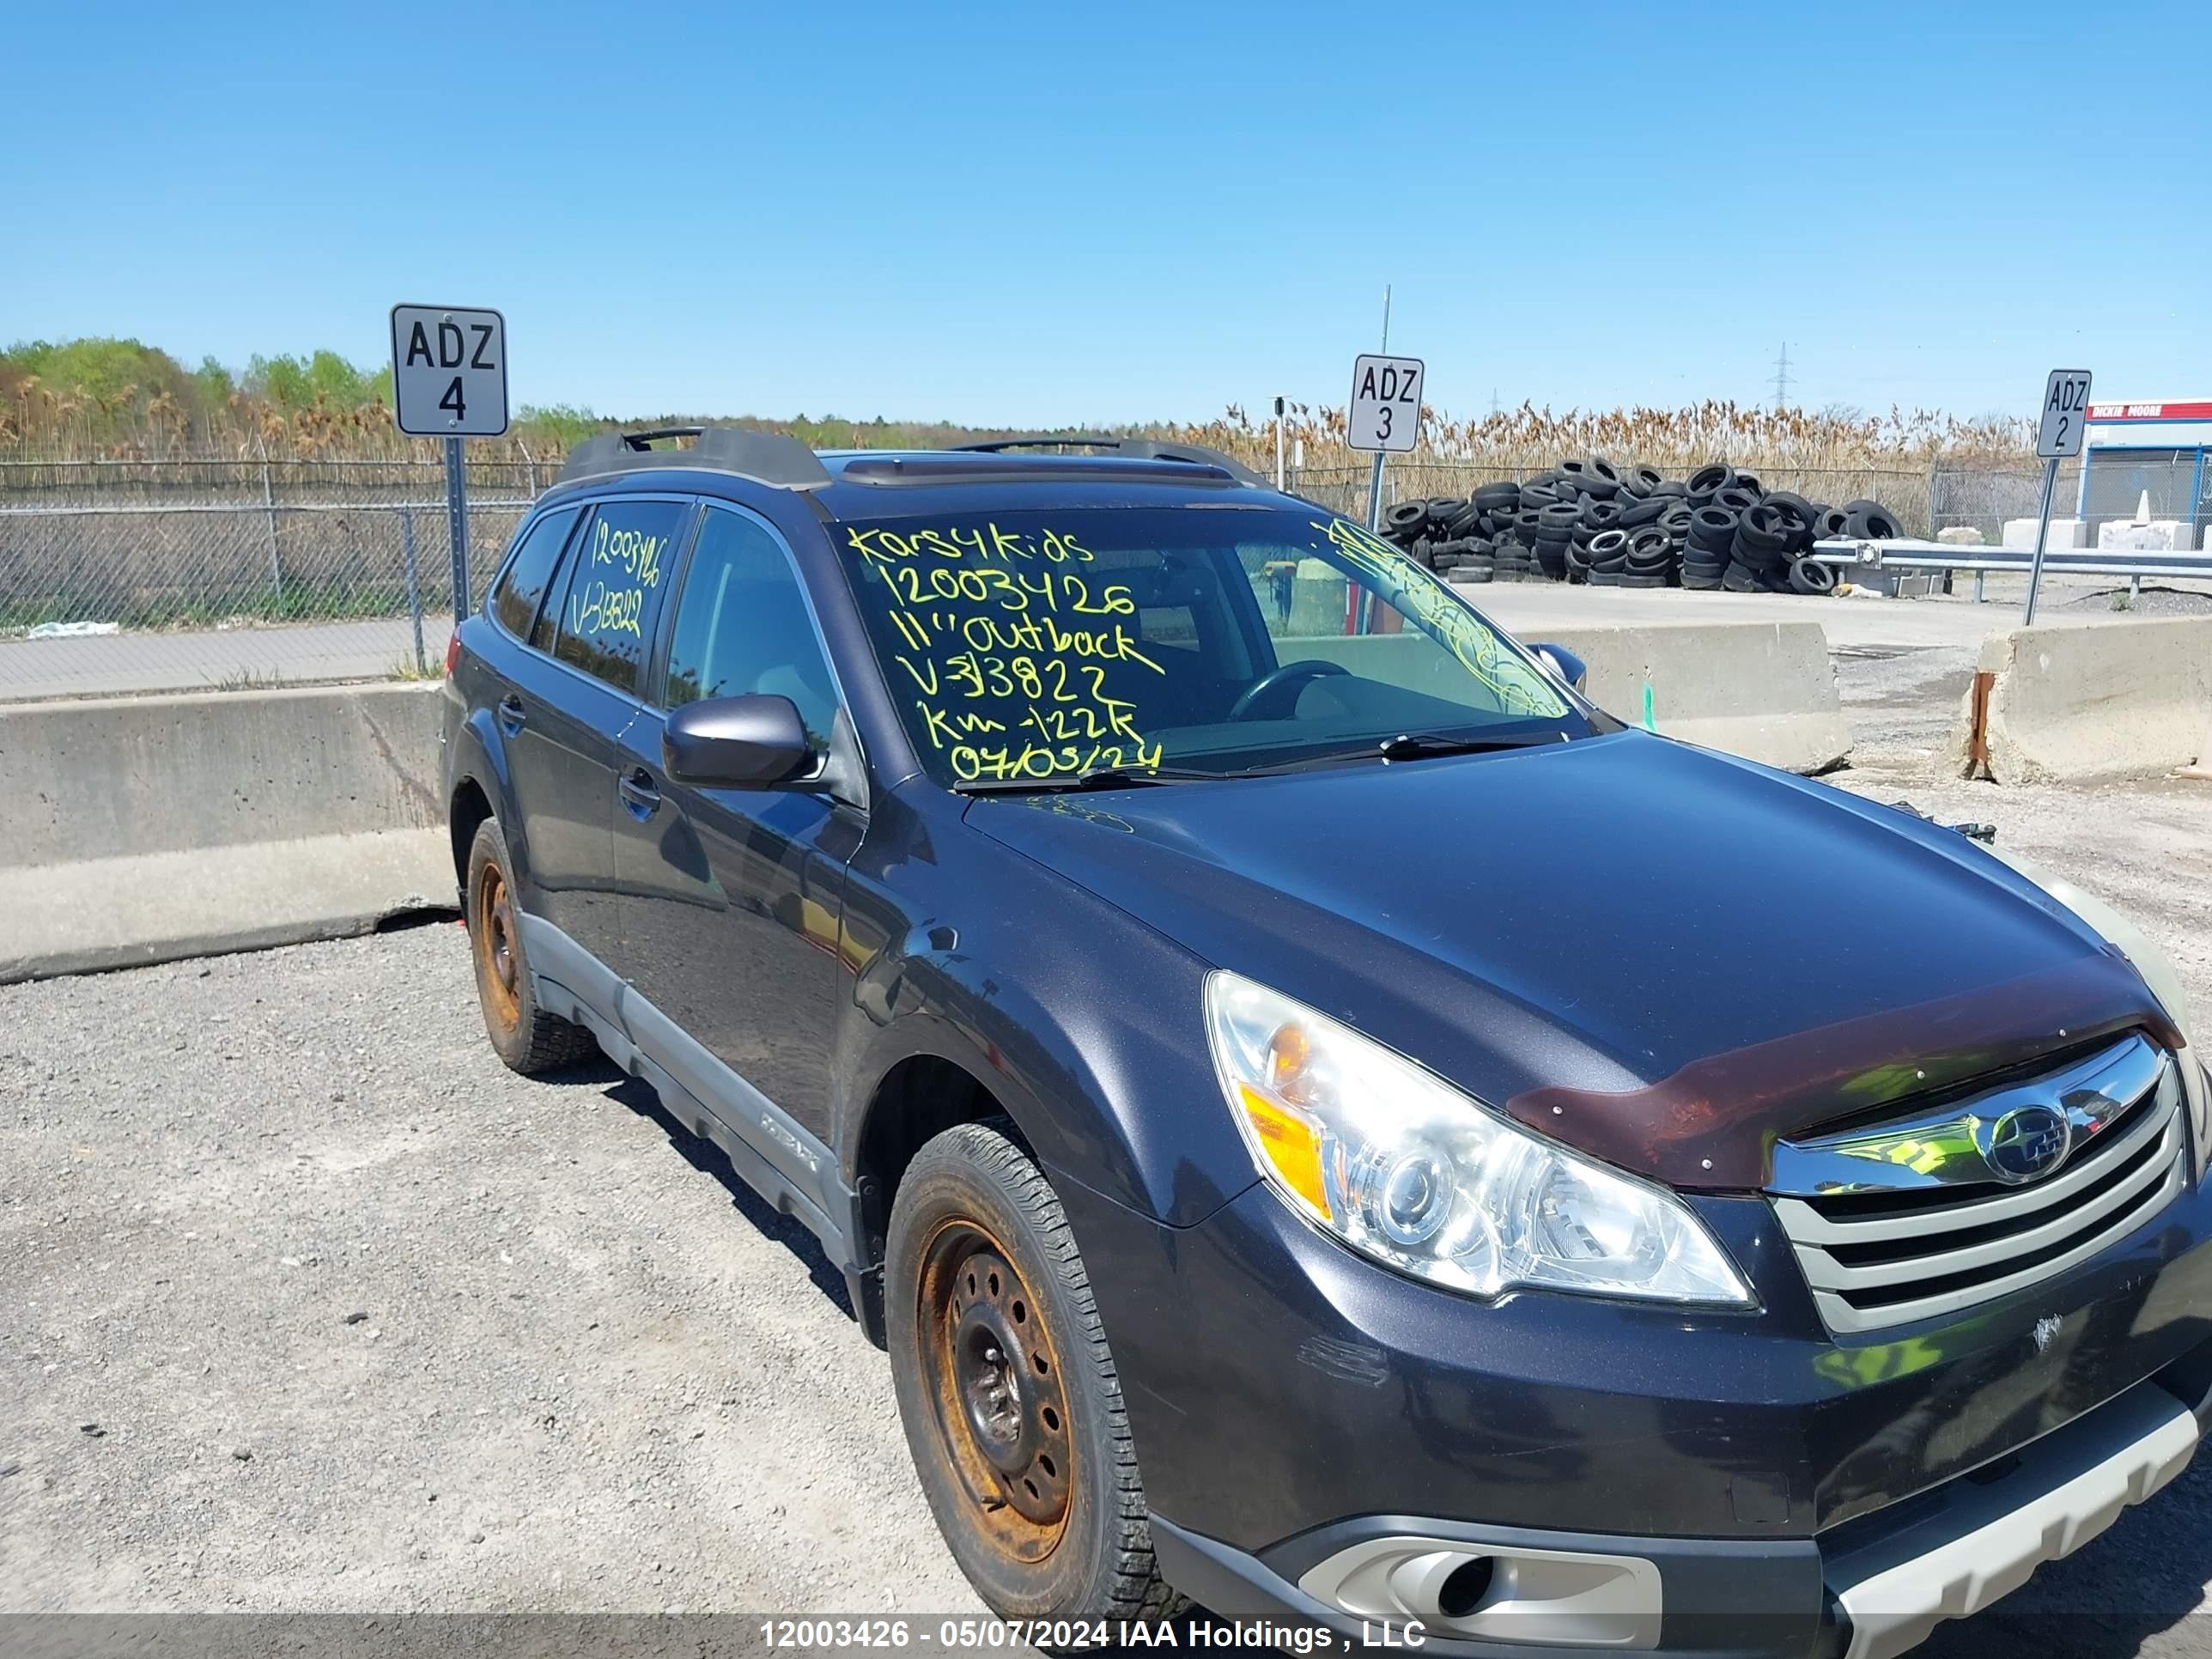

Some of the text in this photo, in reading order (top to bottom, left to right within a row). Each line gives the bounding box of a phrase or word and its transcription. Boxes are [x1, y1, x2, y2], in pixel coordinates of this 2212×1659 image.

[406, 321, 495, 370] ADZ
[439, 376, 466, 421] 4
[1359, 367, 1418, 404] ADZ
[2048, 380, 2087, 411] ADZ
[1376, 406, 1393, 441] 3
[2092, 404, 2162, 418] DICKIE MOORE
[2054, 416, 2069, 447] 2
[879, 565, 1135, 615] 12003426
